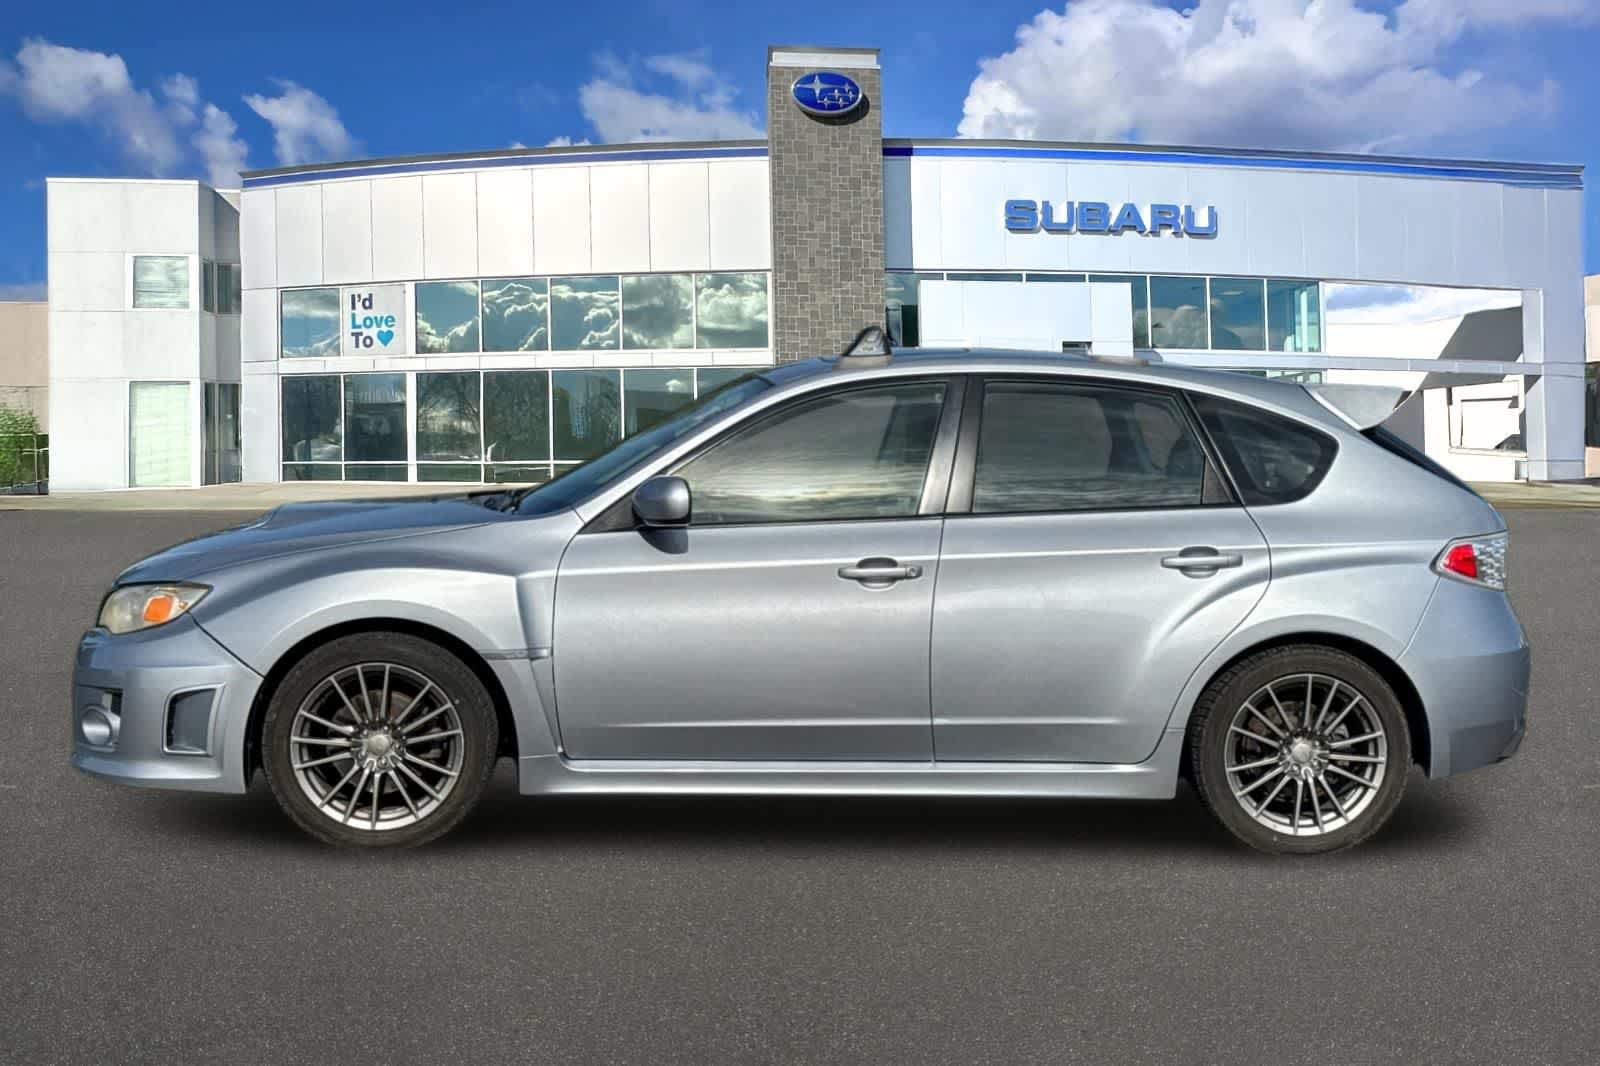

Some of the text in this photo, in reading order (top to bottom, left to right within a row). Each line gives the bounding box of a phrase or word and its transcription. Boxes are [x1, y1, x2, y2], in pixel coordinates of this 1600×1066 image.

[1005, 199, 1217, 237] SUBARU
[351, 293, 373, 311] I'd
[351, 312, 396, 330] Love
[351, 331, 374, 349] To
